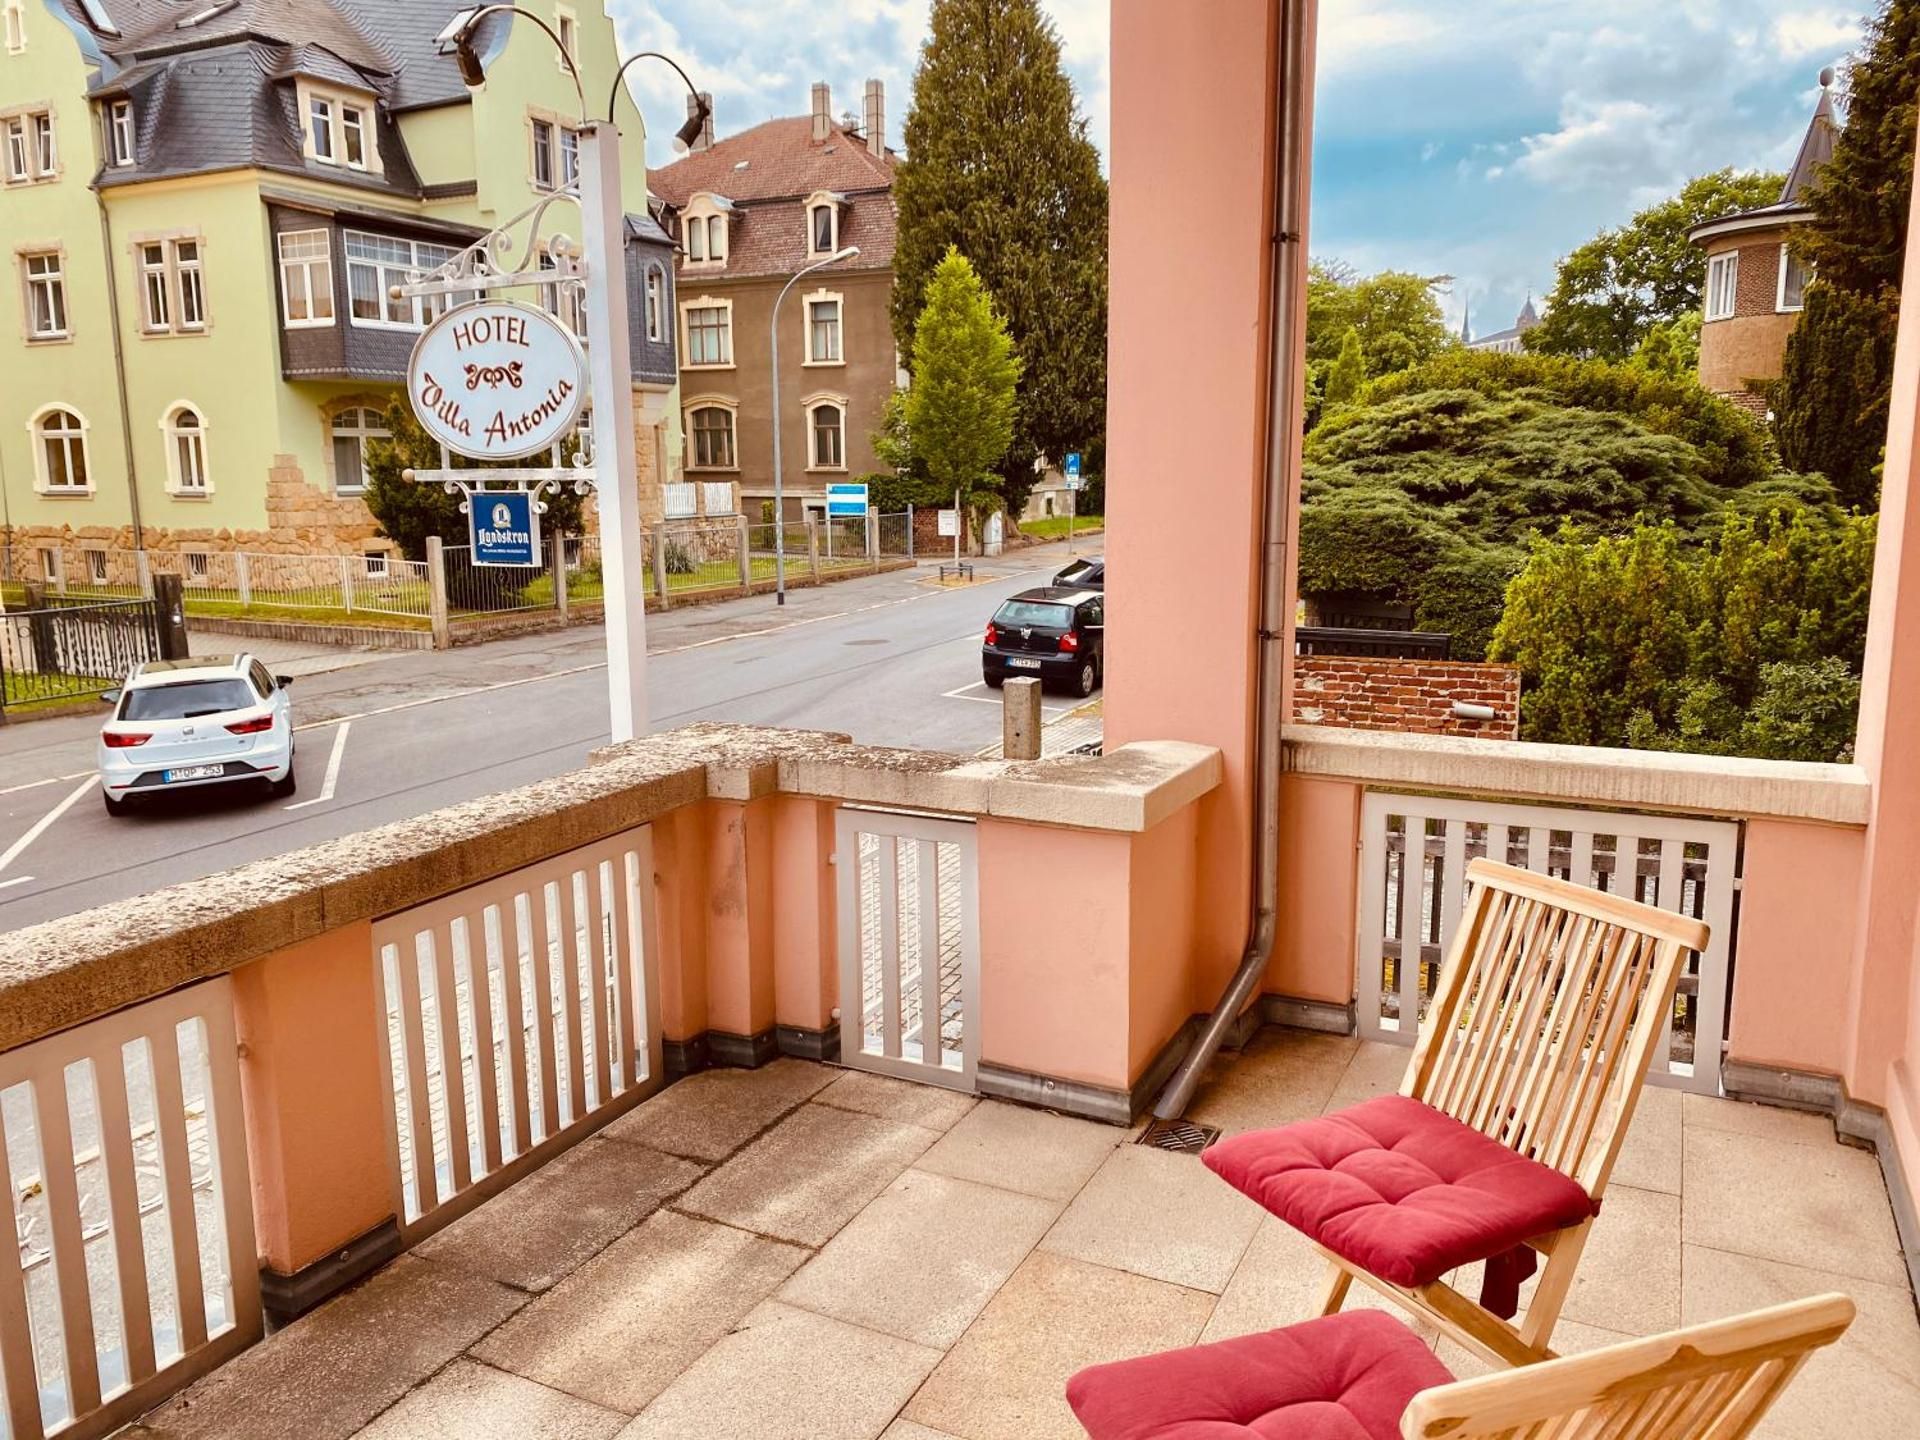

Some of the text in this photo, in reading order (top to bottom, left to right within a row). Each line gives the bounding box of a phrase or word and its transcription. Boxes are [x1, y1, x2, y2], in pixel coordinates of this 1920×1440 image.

[453, 316, 530, 351] HOTEL
[421, 372, 573, 447] Villa Antonia
[478, 528, 529, 547] Landskron
